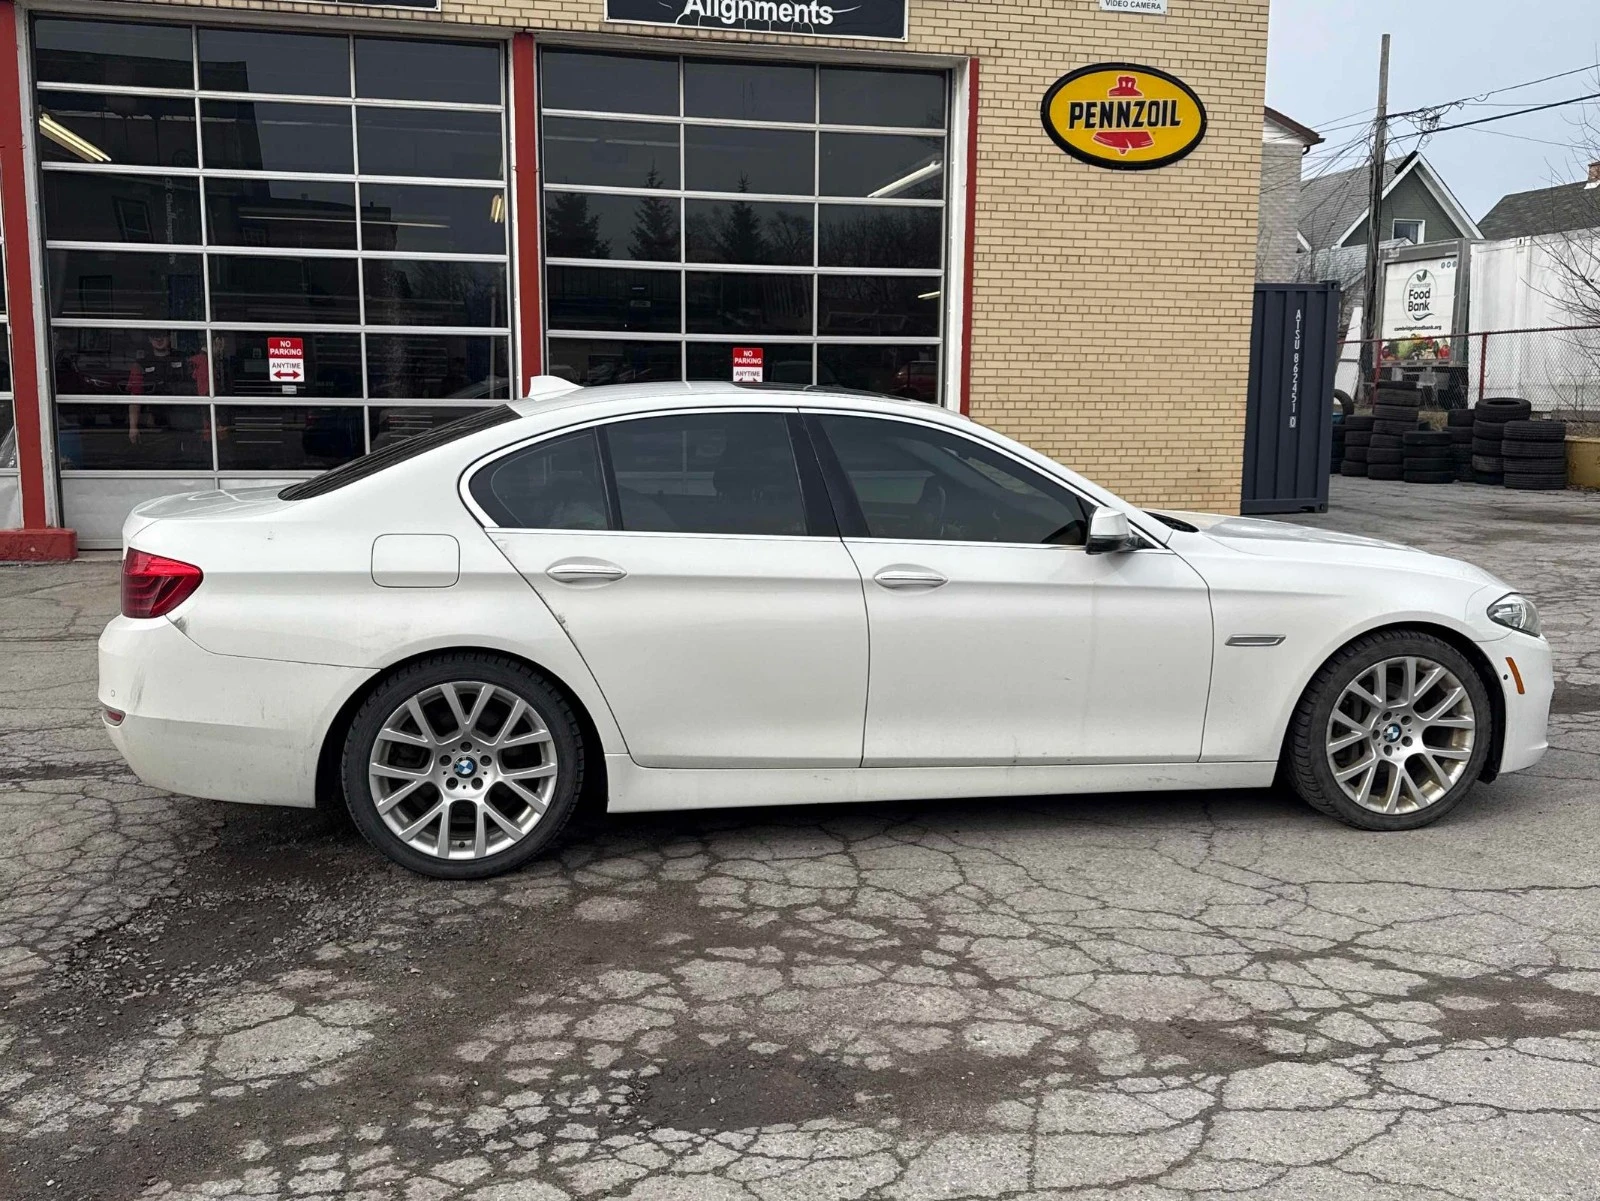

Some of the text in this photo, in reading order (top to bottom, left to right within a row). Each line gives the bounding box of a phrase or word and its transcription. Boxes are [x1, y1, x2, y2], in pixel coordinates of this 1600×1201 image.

[1130, 1, 1161, 10] CAMERA
[683, 0, 833, 25] Alignments
[1068, 100, 1182, 129] PENNZOIL
[1408, 287, 1431, 300] Food
[1407, 300, 1430, 311] Bank
[280, 340, 291, 348] NO
[1291, 352, 1299, 413] 862451
